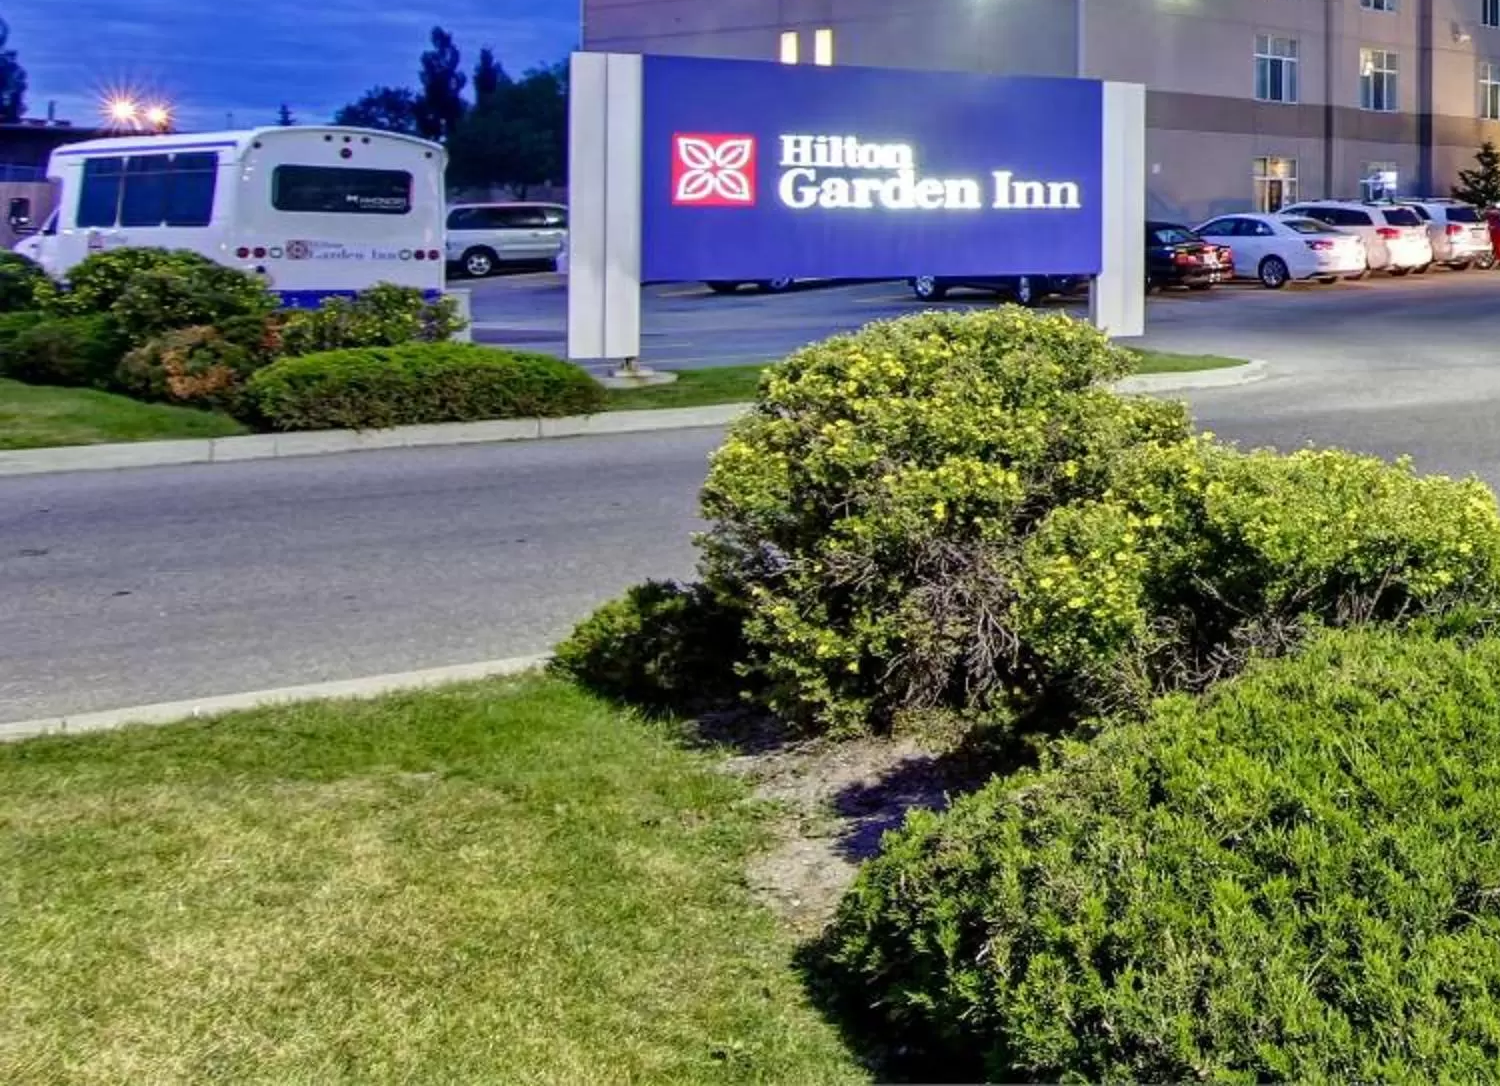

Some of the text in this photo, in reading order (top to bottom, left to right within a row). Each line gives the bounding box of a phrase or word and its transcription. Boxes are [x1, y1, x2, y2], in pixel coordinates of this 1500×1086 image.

[779, 135, 914, 168] Hilton
[778, 167, 1081, 209] Garden Inn
